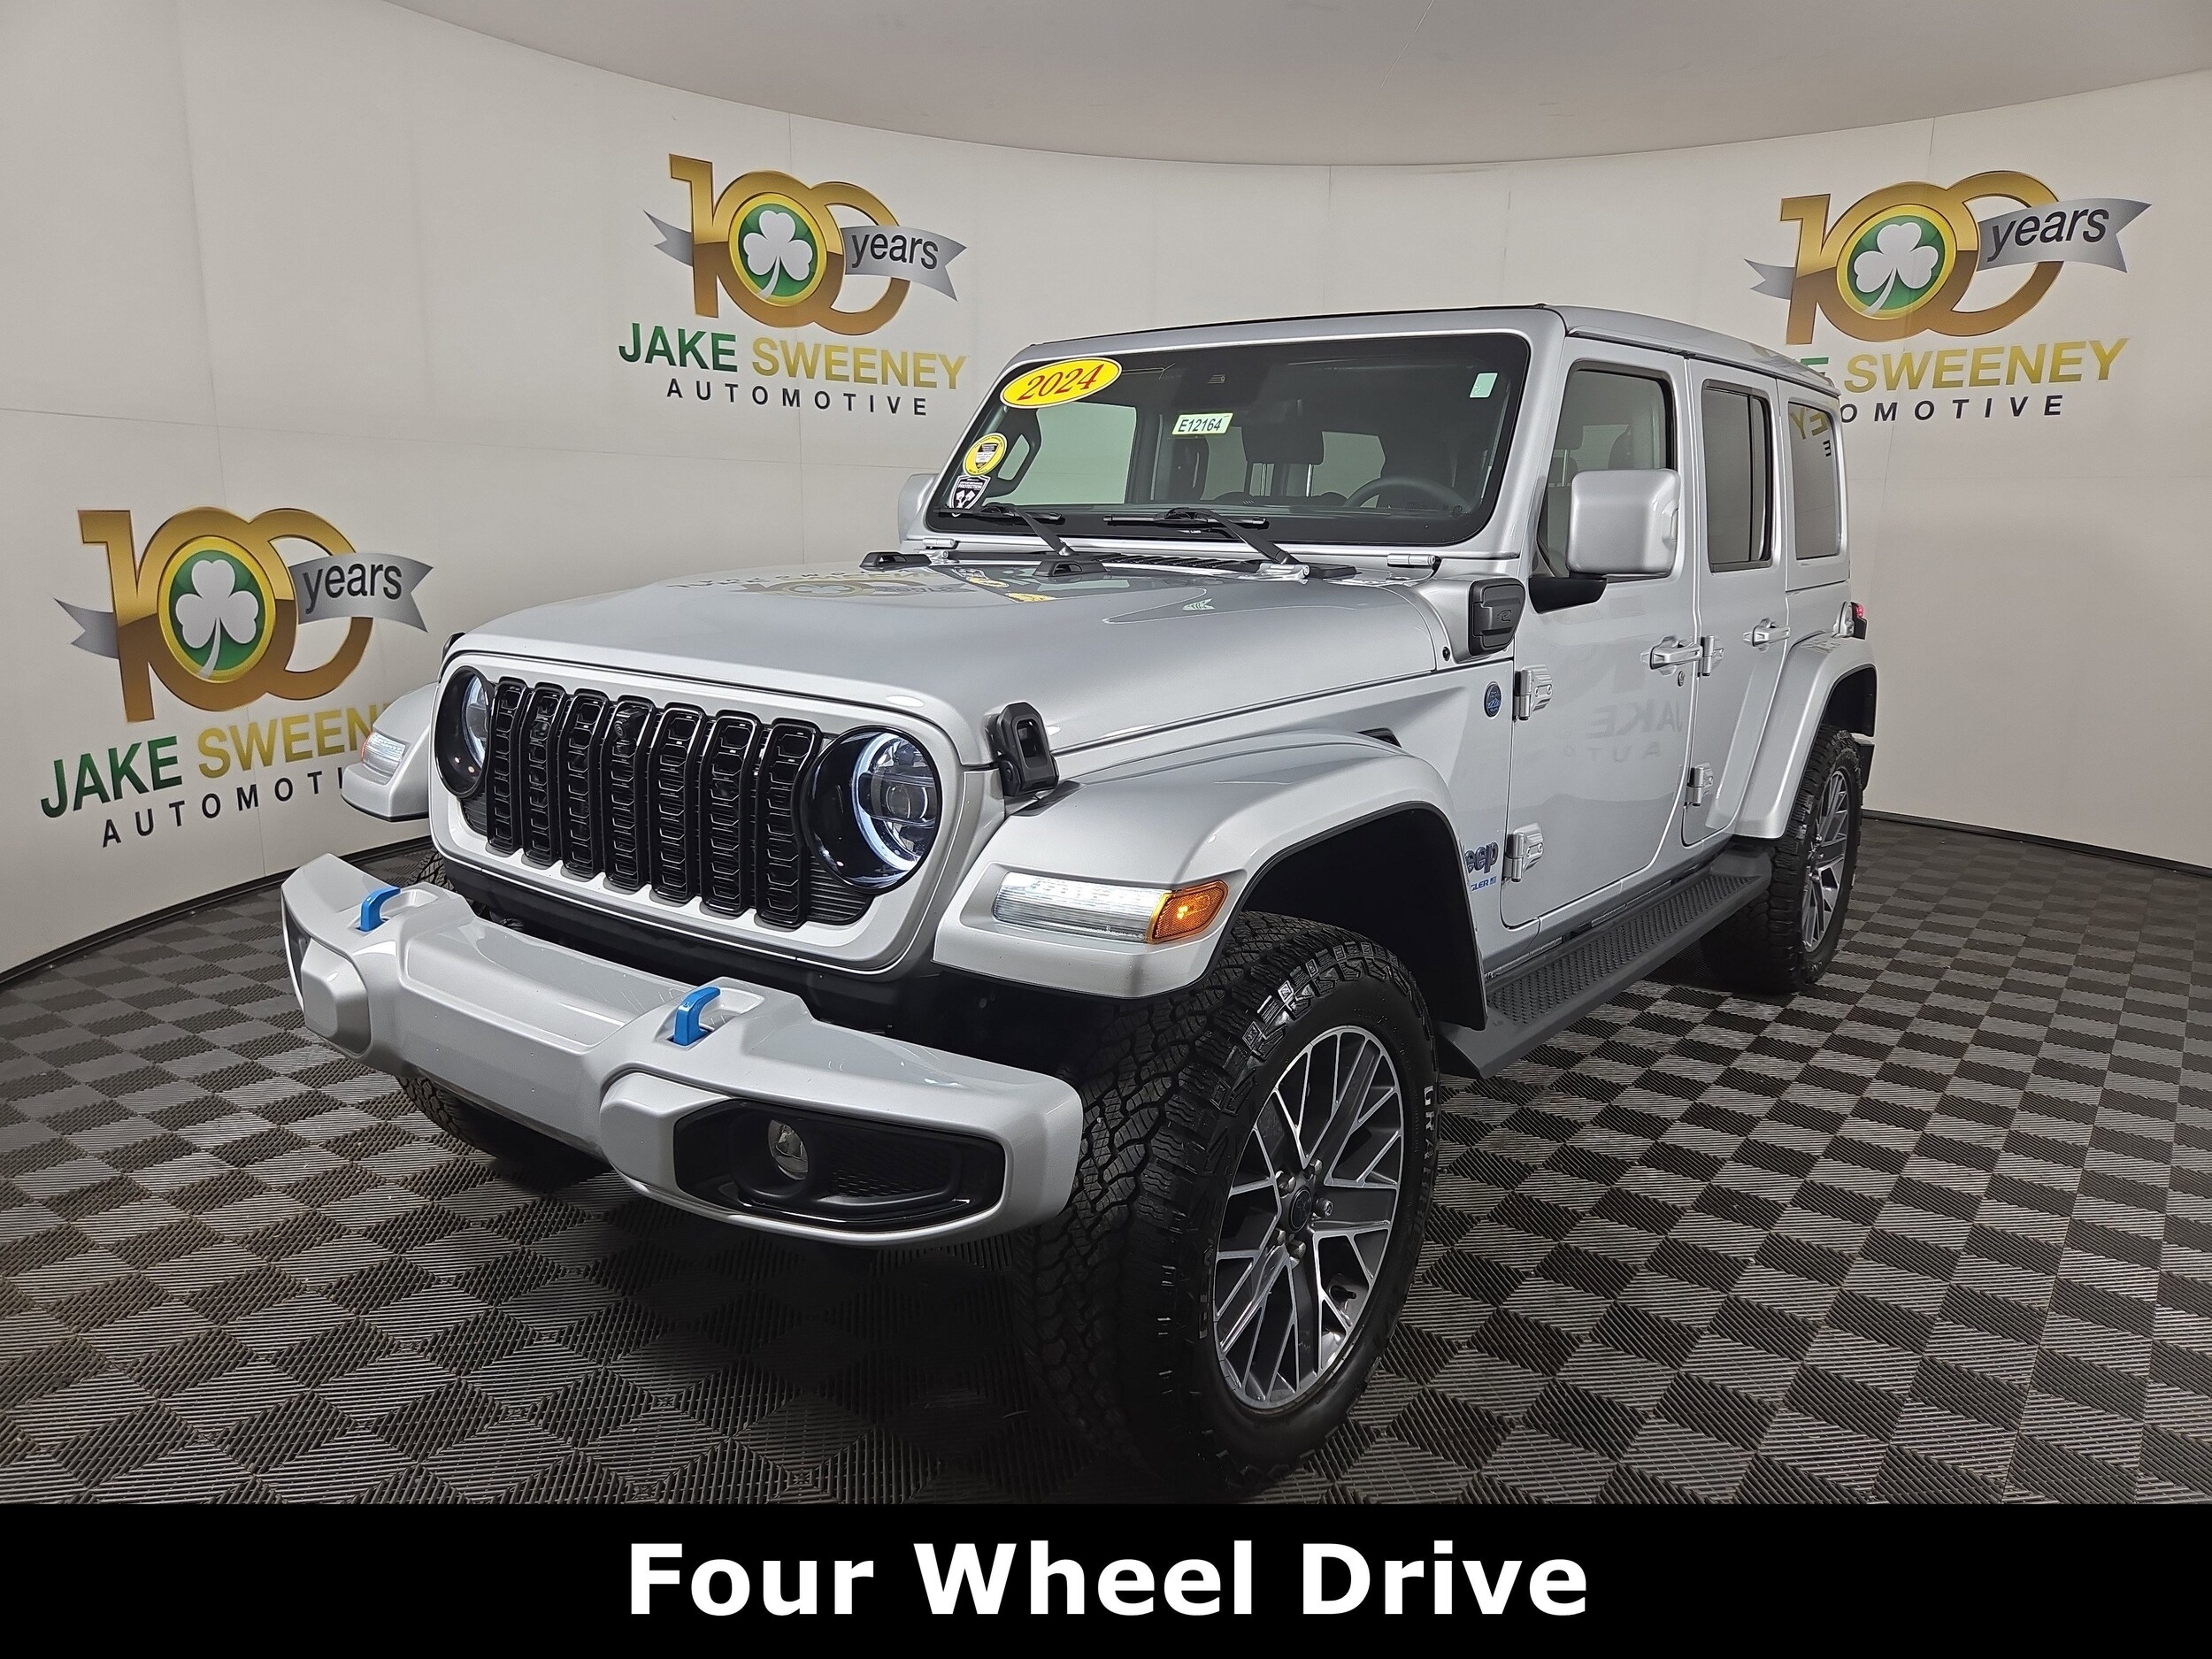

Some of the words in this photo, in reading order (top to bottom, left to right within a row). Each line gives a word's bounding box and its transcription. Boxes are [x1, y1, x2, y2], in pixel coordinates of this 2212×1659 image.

[851, 234, 939, 269] years
[1987, 207, 2110, 263] years
[618, 323, 738, 373] JAKE
[752, 336, 966, 390] SWEENEY
[1844, 338, 2130, 393] SWEENEY
[667, 378, 926, 416] AUTOMOTIVE
[1017, 364, 1104, 401] 2024
[1178, 418, 1223, 432] E12164
[1840, 395, 2063, 423] OMOTIVE
[303, 563, 403, 613] years
[40, 737, 182, 818] JAKE
[197, 703, 389, 779] SWEEN
[103, 766, 342, 848] AUTOMOTI
[1463, 841, 1499, 874] eep
